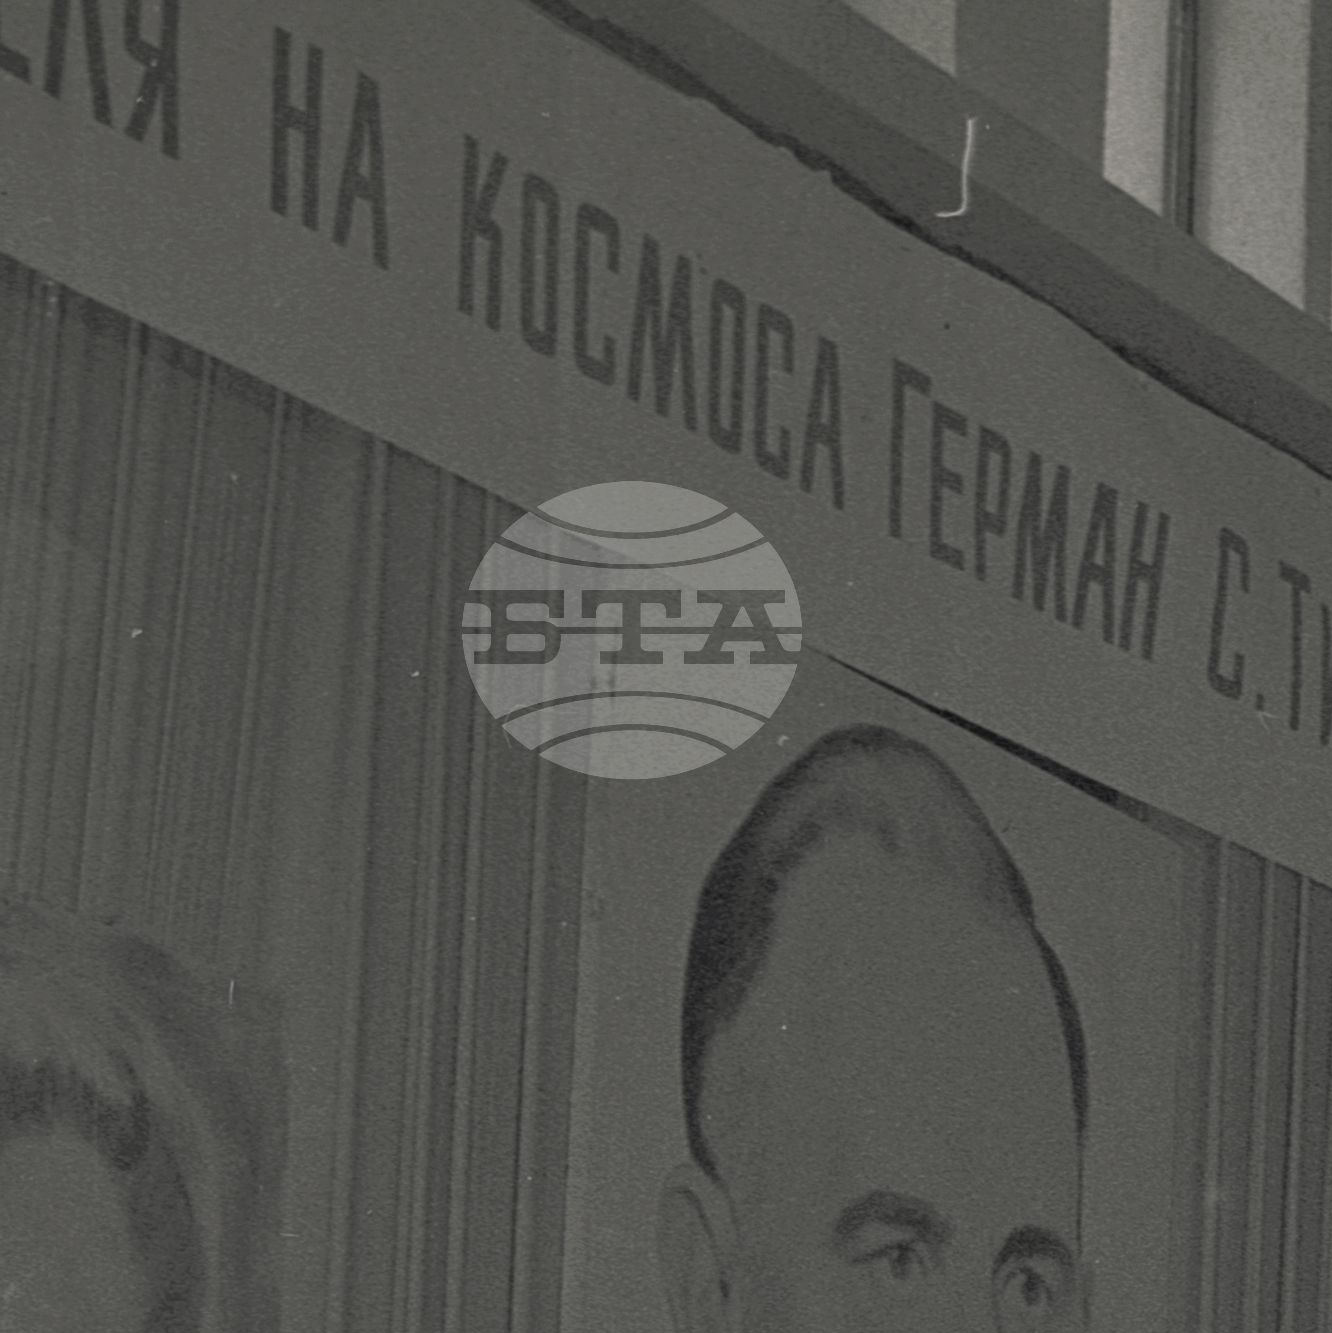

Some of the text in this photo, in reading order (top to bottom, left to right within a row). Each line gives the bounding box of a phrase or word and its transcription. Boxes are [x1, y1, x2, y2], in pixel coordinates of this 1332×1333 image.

[0, 0, 181, 160] ЛЯ
[270, 26, 389, 270] НА
[458, 133, 845, 511] КОСМОСА
[888, 357, 1171, 662] ГЕРМАН
